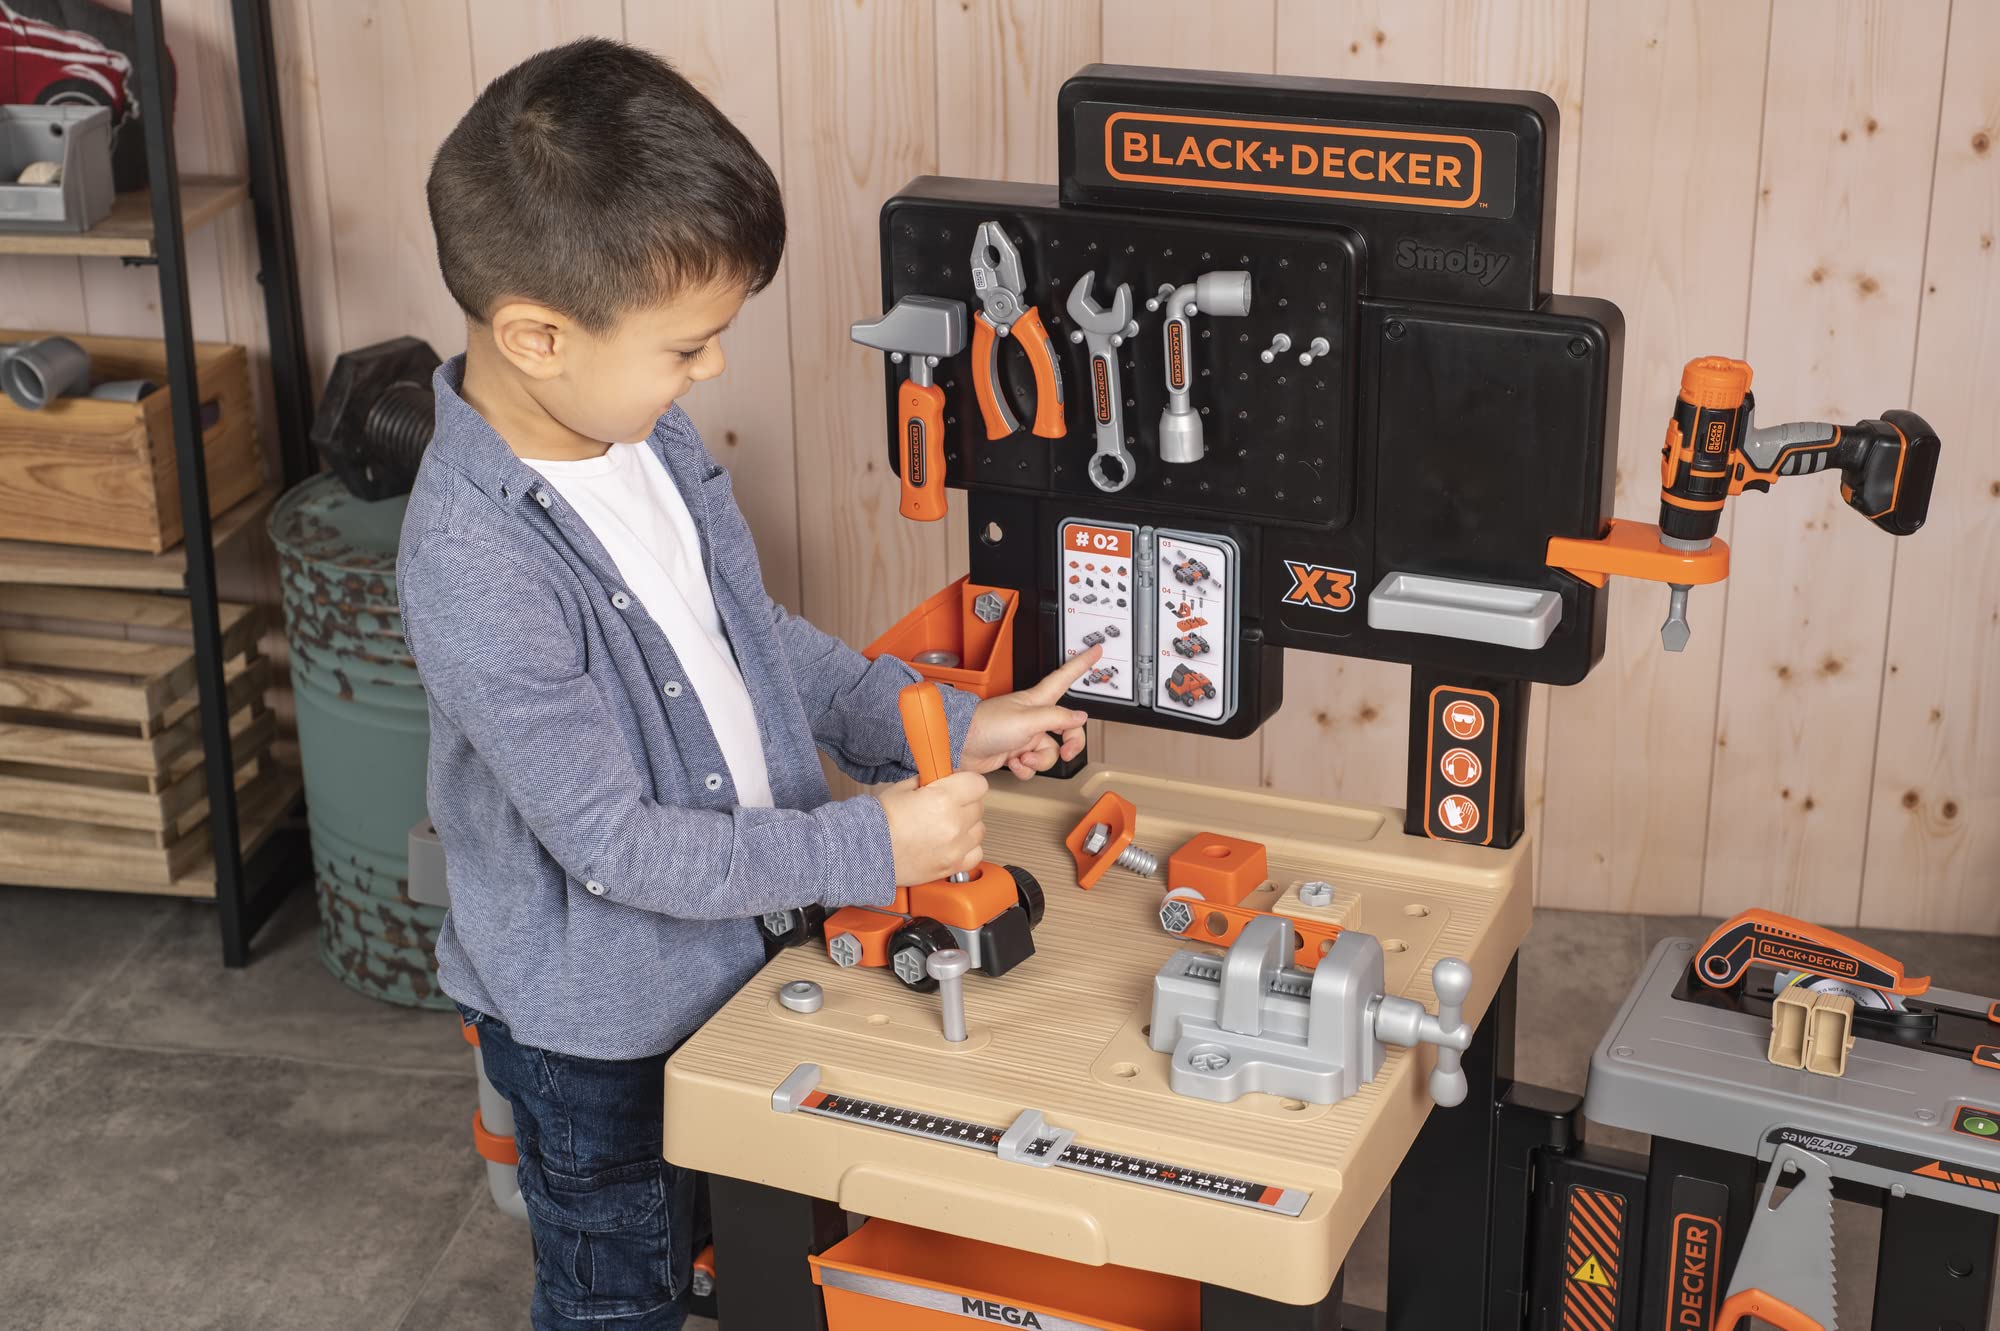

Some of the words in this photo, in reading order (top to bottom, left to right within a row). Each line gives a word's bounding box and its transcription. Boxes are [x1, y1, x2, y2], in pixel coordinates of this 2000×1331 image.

[1122, 130, 1463, 189] BLACK+DECKER
[1396, 239, 1510, 288] Smoby
[1172, 326, 1182, 383] BLACK+DECKER
[1097, 362, 1107, 418] BLACK+DECKER
[912, 426, 920, 480] BLACK+DECKER
[1714, 424, 1723, 451] DECKER
[1075, 531, 1090, 547] #
[1093, 533, 1119, 551] 02
[1286, 563, 1354, 610] X3
[1763, 944, 1854, 972] BLACK+DECKER
[926, 1121, 936, 1129] 6
[960, 1128, 969, 1136] 8
[1076, 1153, 1088, 1161] 15
[1093, 1156, 1105, 1164] 16
[1128, 1163, 1140, 1171] 18
[1145, 1167, 1158, 1175] 19
[1160, 1170, 1177, 1179] 20
[1178, 1174, 1193, 1182] 21
[1195, 1178, 1212, 1187] 22
[1213, 1181, 1229, 1190] 23
[1230, 1185, 1247, 1194] 24
[1679, 1225, 1709, 1331] DECKER
[961, 1296, 1043, 1330] MEGA
